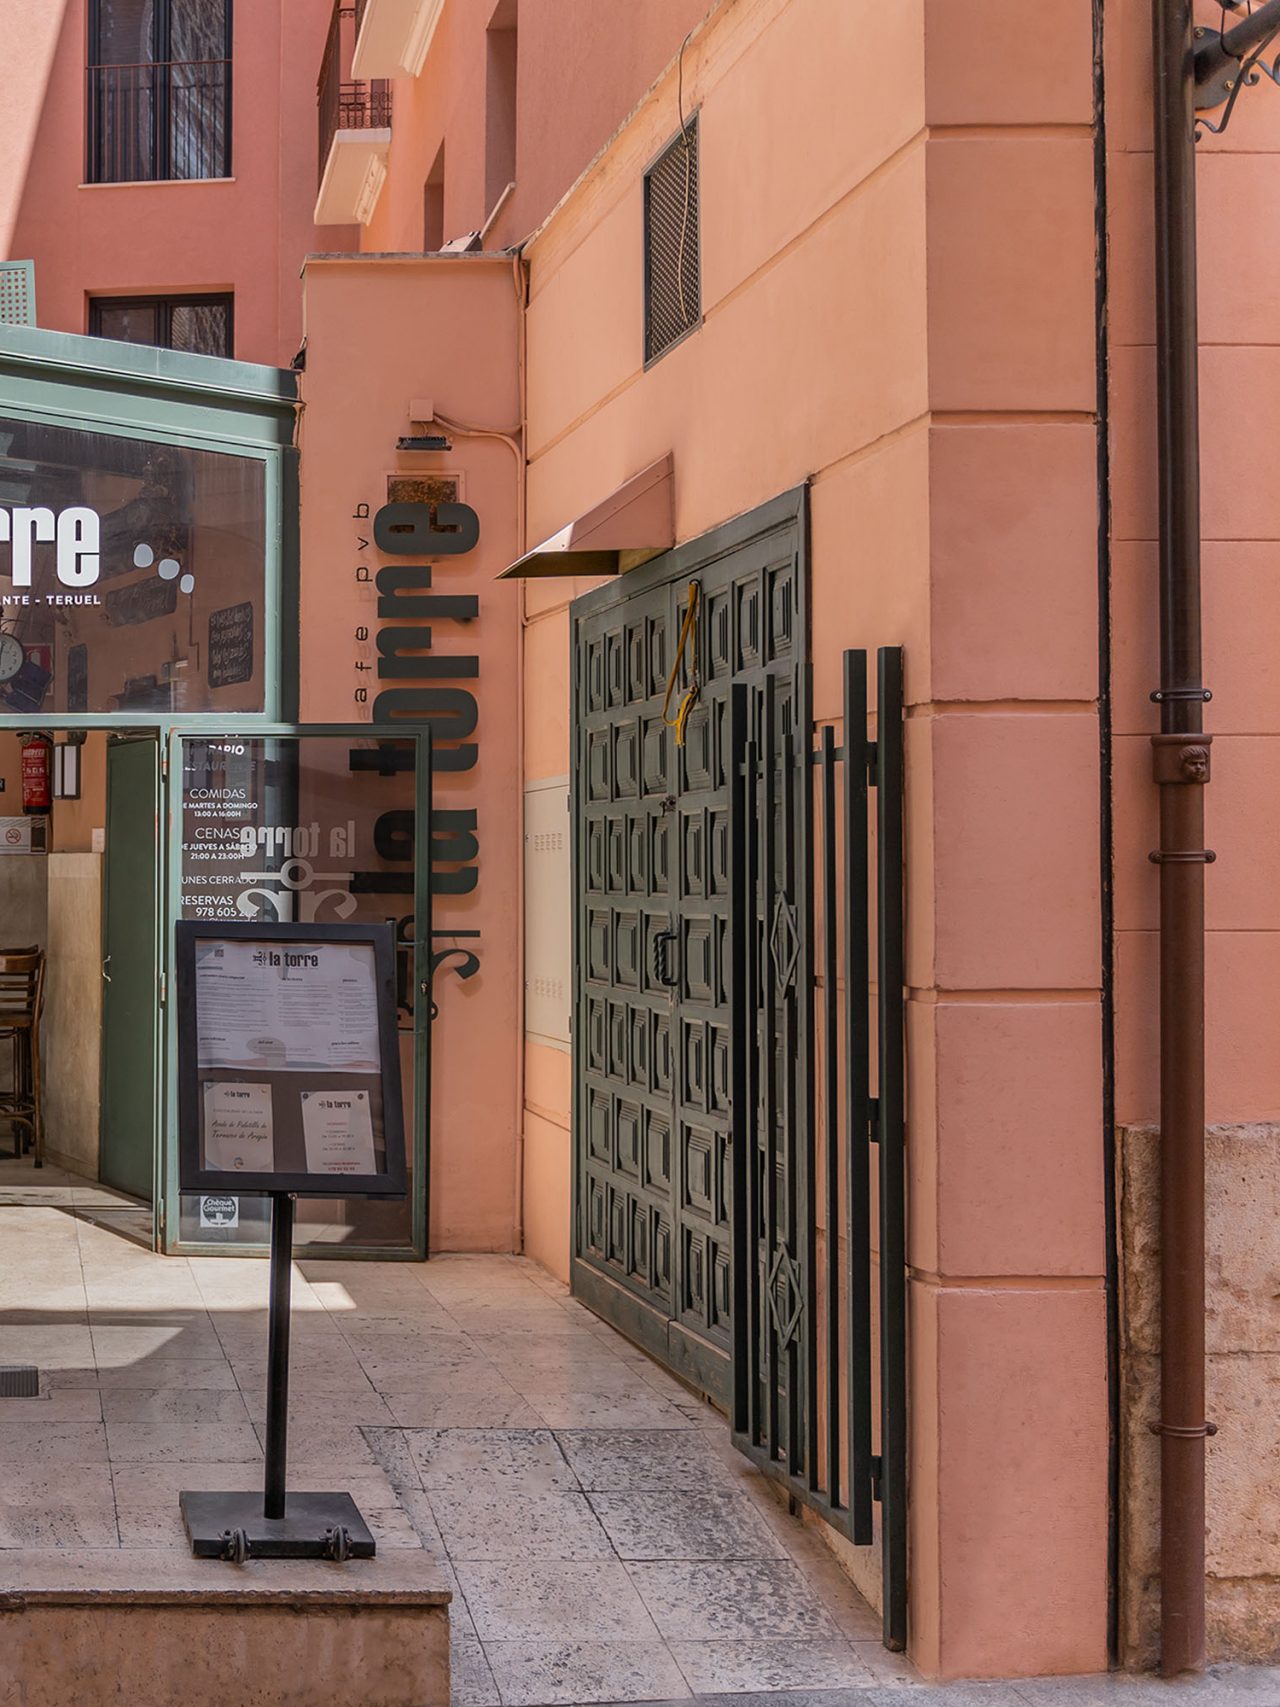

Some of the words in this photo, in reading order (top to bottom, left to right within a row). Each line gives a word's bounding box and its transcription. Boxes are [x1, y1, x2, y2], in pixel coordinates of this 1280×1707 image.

[46, 594, 101, 605] TERUEL
[349, 502, 480, 776] torre
[189, 788, 246, 800] COMIDAS
[195, 827, 240, 839] CENAS
[190, 843, 218, 851] JUEVES
[181, 876, 207, 884] UNES
[196, 907, 214, 917] 978
[217, 907, 237, 917] 605
[269, 951, 281, 966] la
[285, 953, 319, 967] torre
[334, 1100, 351, 1108] torre
